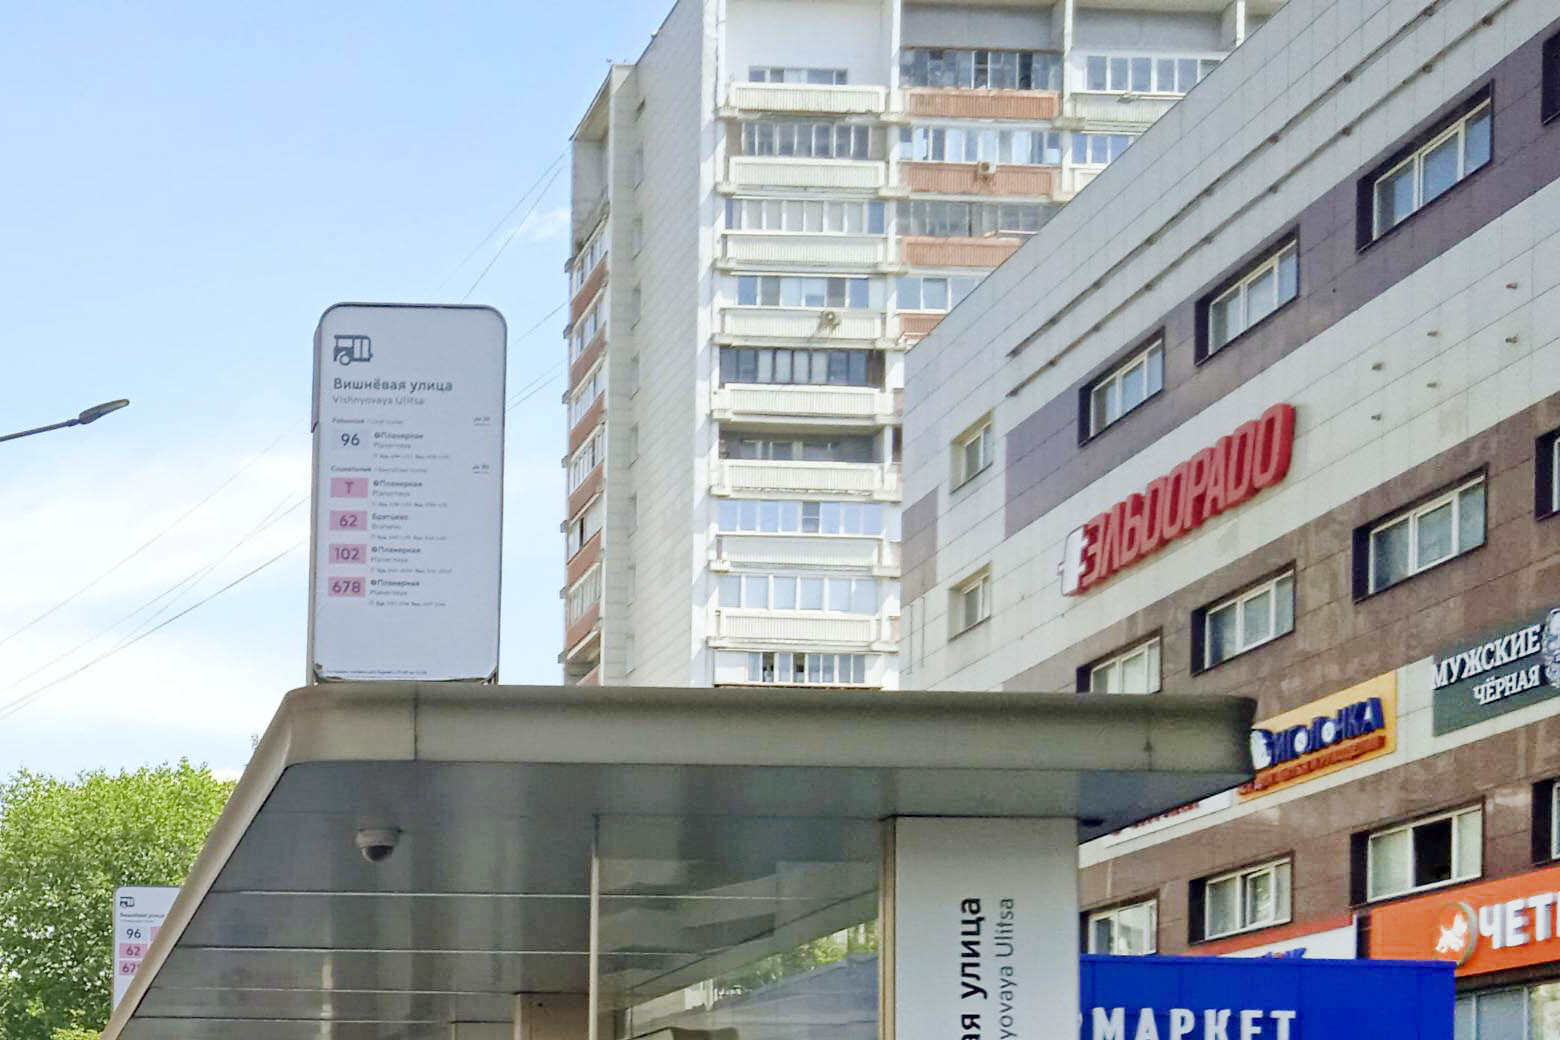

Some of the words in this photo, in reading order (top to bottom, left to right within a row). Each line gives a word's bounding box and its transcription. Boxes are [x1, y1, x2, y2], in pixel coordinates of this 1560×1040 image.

[333, 377, 406, 391] Вишнёвая
[410, 379, 453, 393] улица
[341, 433, 360, 446] 96
[1079, 403, 1296, 590] ЭЛЬДОРАДО
[339, 514, 358, 527] 62
[335, 547, 360, 560] 102
[332, 581, 361, 593] 678
[1432, 624, 1541, 690] МУЖСКИЕ
[1472, 664, 1540, 705] ЧЁРНАЯ
[995, 898, 1014, 957] Ulitsa
[1479, 891, 1560, 950] ЧЕТ
[126, 928, 141, 939] 96
[126, 946, 141, 956] 62
[961, 898, 988, 1000] улица
